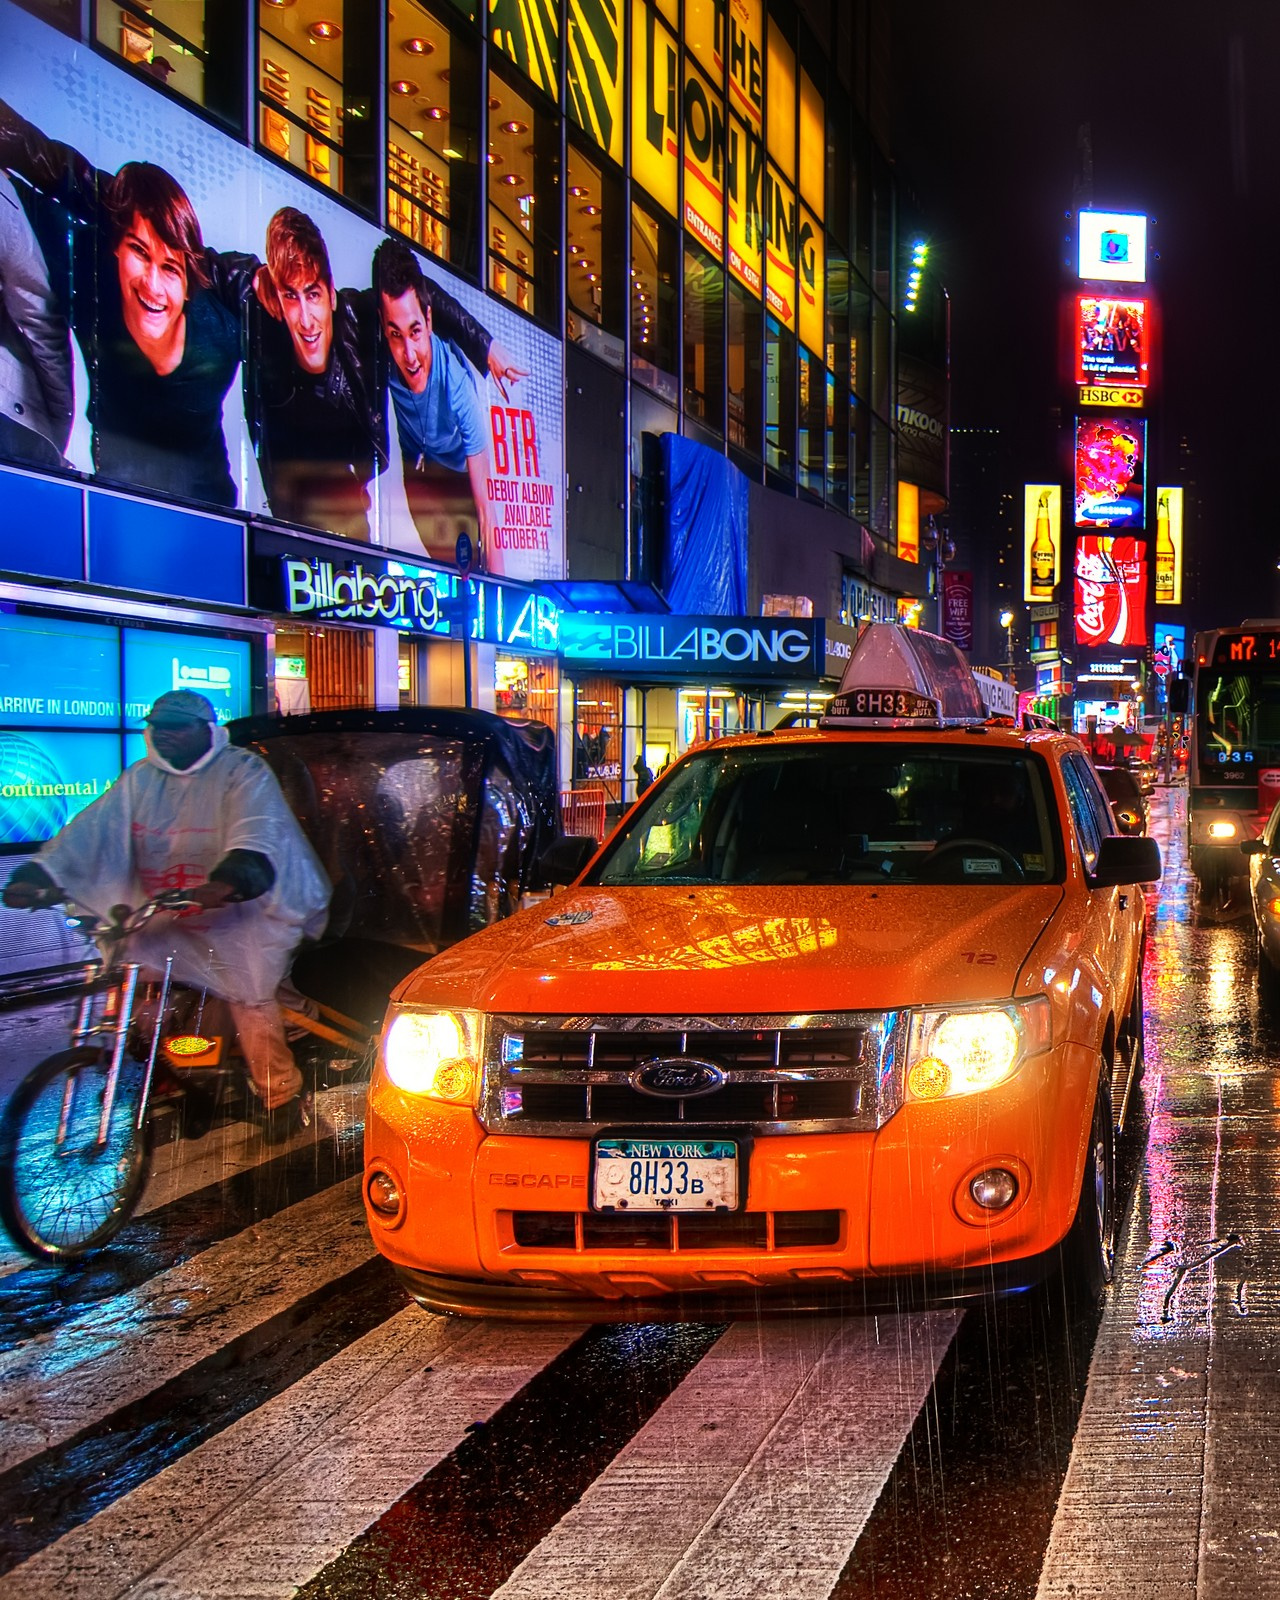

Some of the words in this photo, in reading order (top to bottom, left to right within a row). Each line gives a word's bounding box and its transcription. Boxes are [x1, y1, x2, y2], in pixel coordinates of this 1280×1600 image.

[686, 205, 722, 252] ENTRANCE
[730, 251, 742, 272] ON
[743, 265, 760, 289] 45TH
[765, 286, 783, 312] STREET
[1081, 389, 1120, 403] HSBC
[490, 405, 540, 478] BTR
[486, 478, 519, 503] DEBUT
[522, 482, 555, 506] ALBUM
[504, 503, 552, 528] AVAILABLE
[1088, 505, 1133, 515] SAMSUNG
[493, 527, 539, 550] OCTOBER
[540, 530, 549, 550] 11
[1157, 555, 1174, 563] orona
[948, 598, 969, 608] FREE
[614, 624, 811, 663] BILLABONG
[1230, 636, 1256, 660] M7
[0, 697, 44, 715] ARRIVE
[47, 699, 60, 714] IN
[64, 700, 114, 717] LONDON
[832, 706, 850, 715] DUTY
[834, 698, 847, 706] OFF
[856, 693, 906, 714] 8H33
[1223, 771, 1245, 780] 3962
[960, 951, 997, 966] 12
[656, 1067, 698, 1089] Ford
[630, 1144, 662, 1158] NEW
[667, 1143, 704, 1159] YORK
[488, 1173, 586, 1189] ESCAPE
